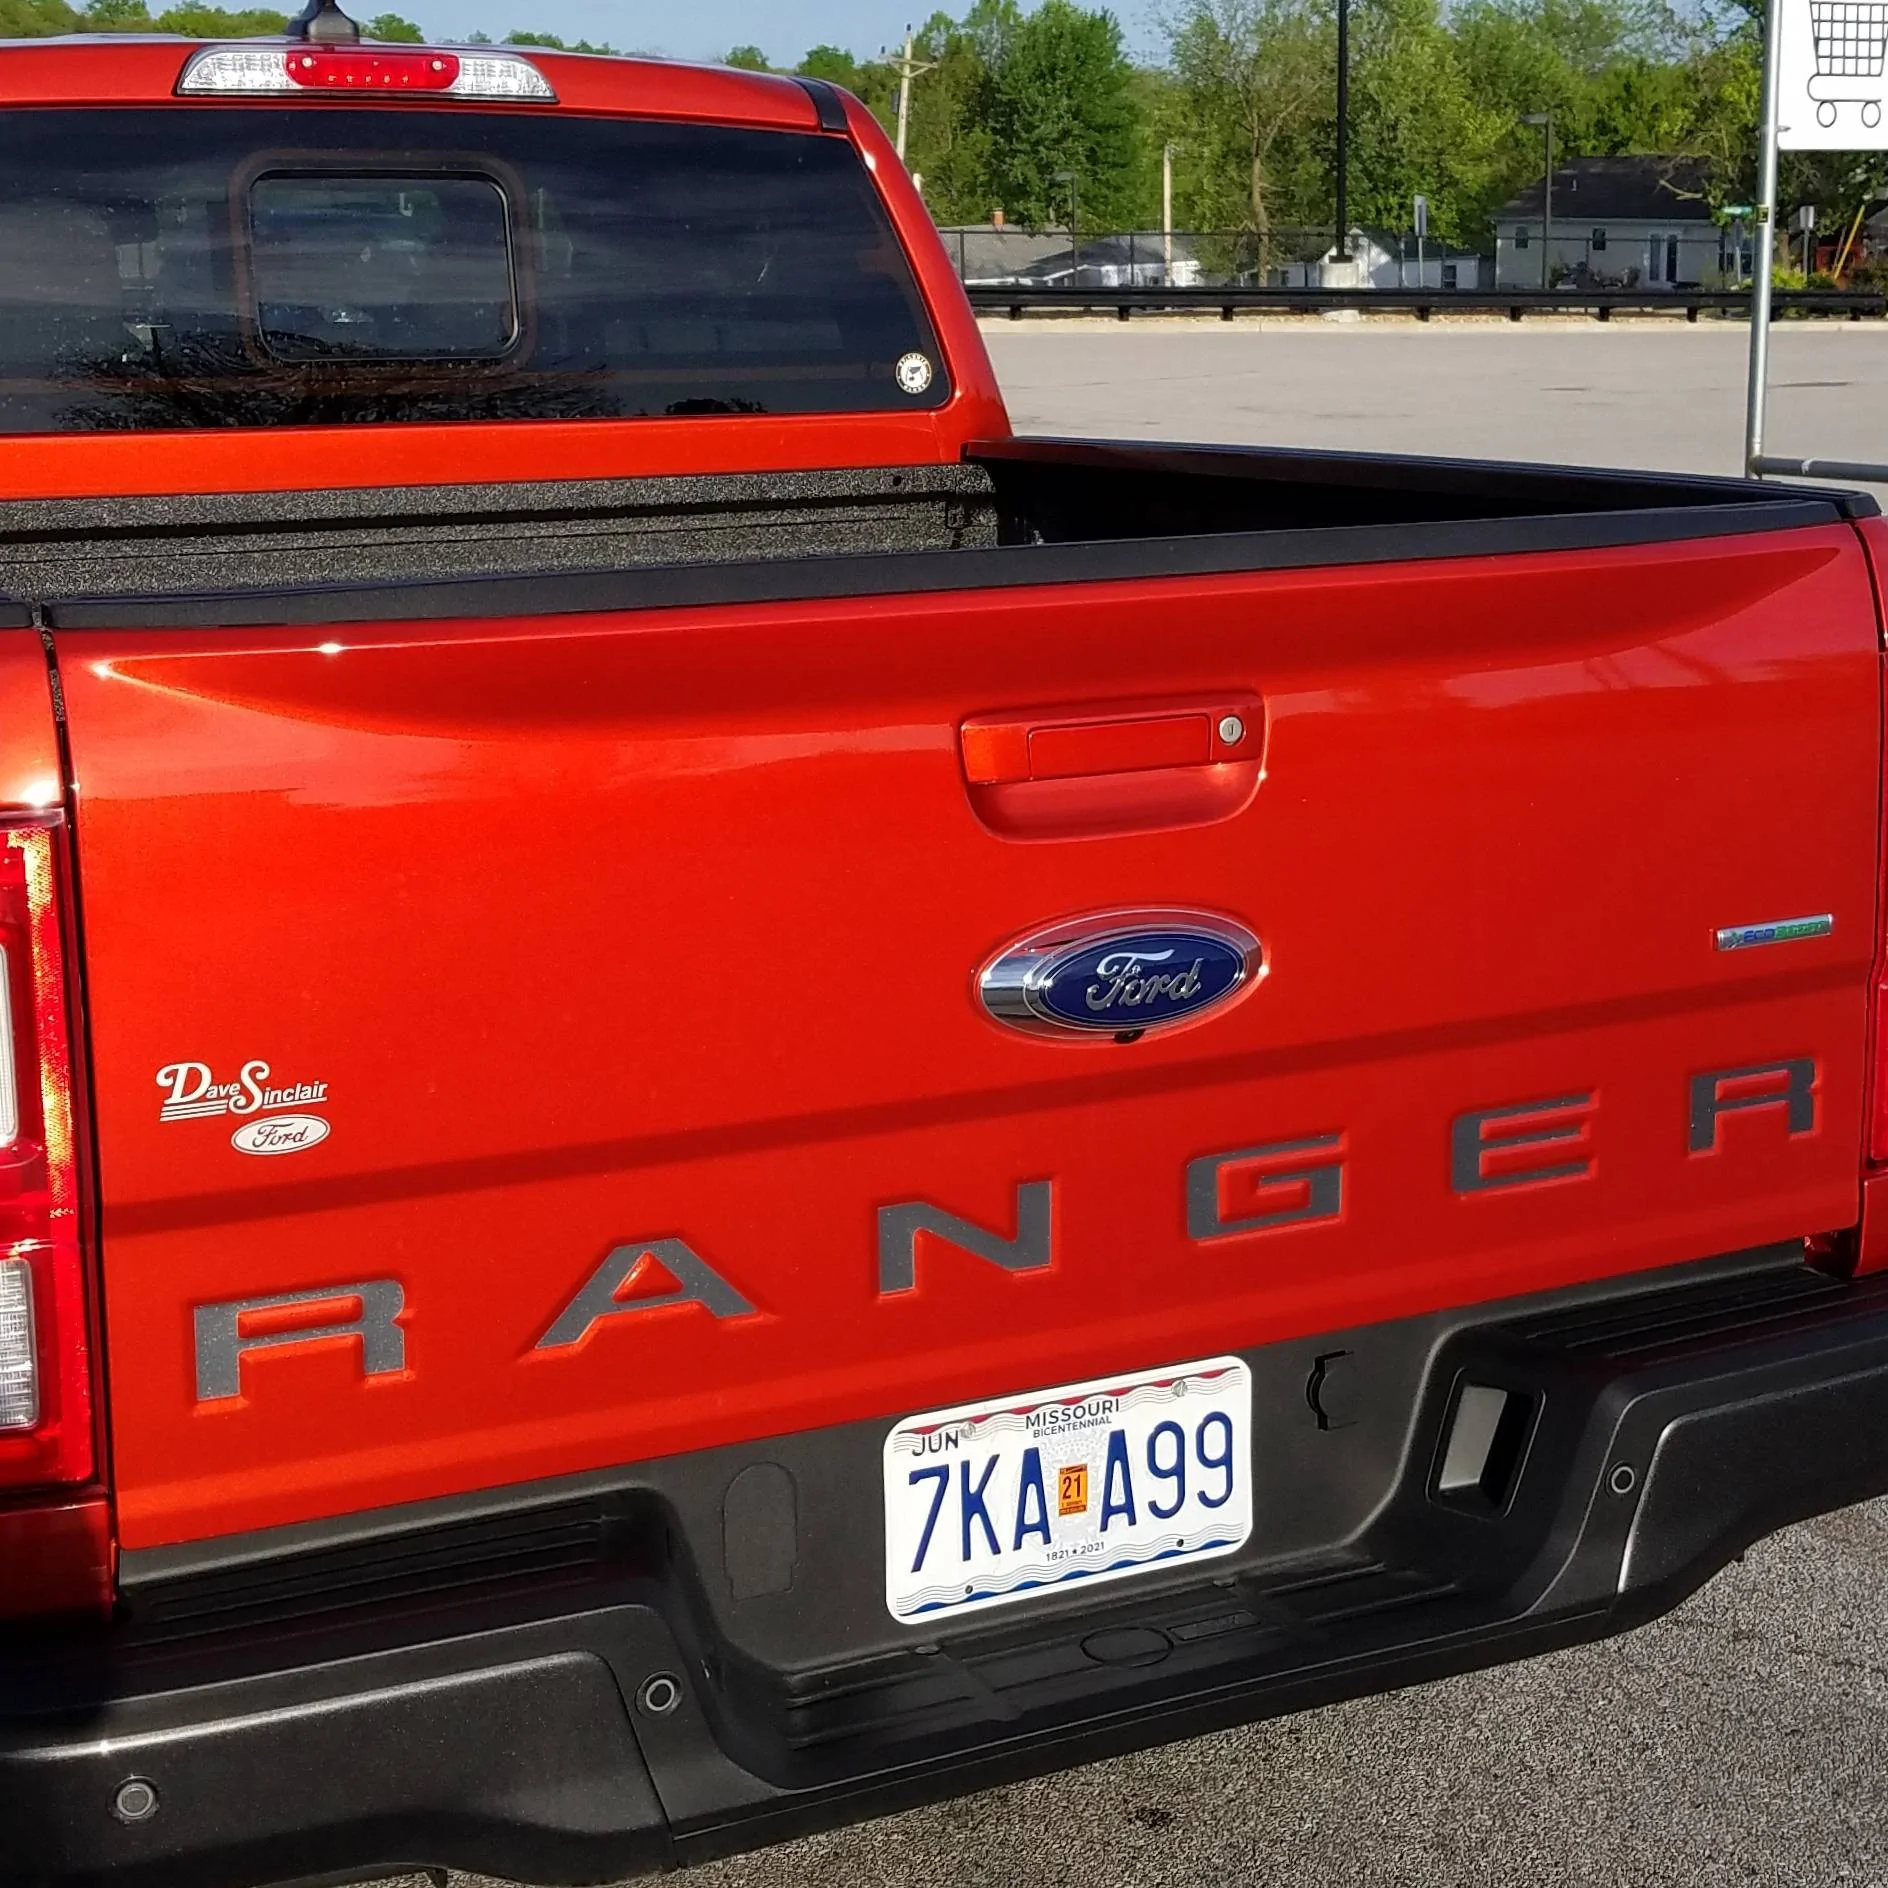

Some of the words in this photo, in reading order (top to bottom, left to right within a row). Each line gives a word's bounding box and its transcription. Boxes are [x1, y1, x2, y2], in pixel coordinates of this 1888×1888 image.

[1086, 949, 1204, 1011] Ford
[156, 1062, 240, 1104] Dave
[229, 1059, 329, 1114] Sinclair
[252, 1122, 309, 1148] Ford
[193, 1057, 1817, 1402] RANGER
[1025, 1397, 1120, 1430] MISSOURI
[1032, 1416, 1112, 1438] BICENTENNIAL
[911, 1429, 959, 1456] JUN
[908, 1446, 1052, 1574] 7KA
[1099, 1410, 1234, 1533] A99
[1062, 1473, 1081, 1500] 21
[1046, 1549, 1069, 1562] 1821
[1080, 1541, 1105, 1554] 2021
